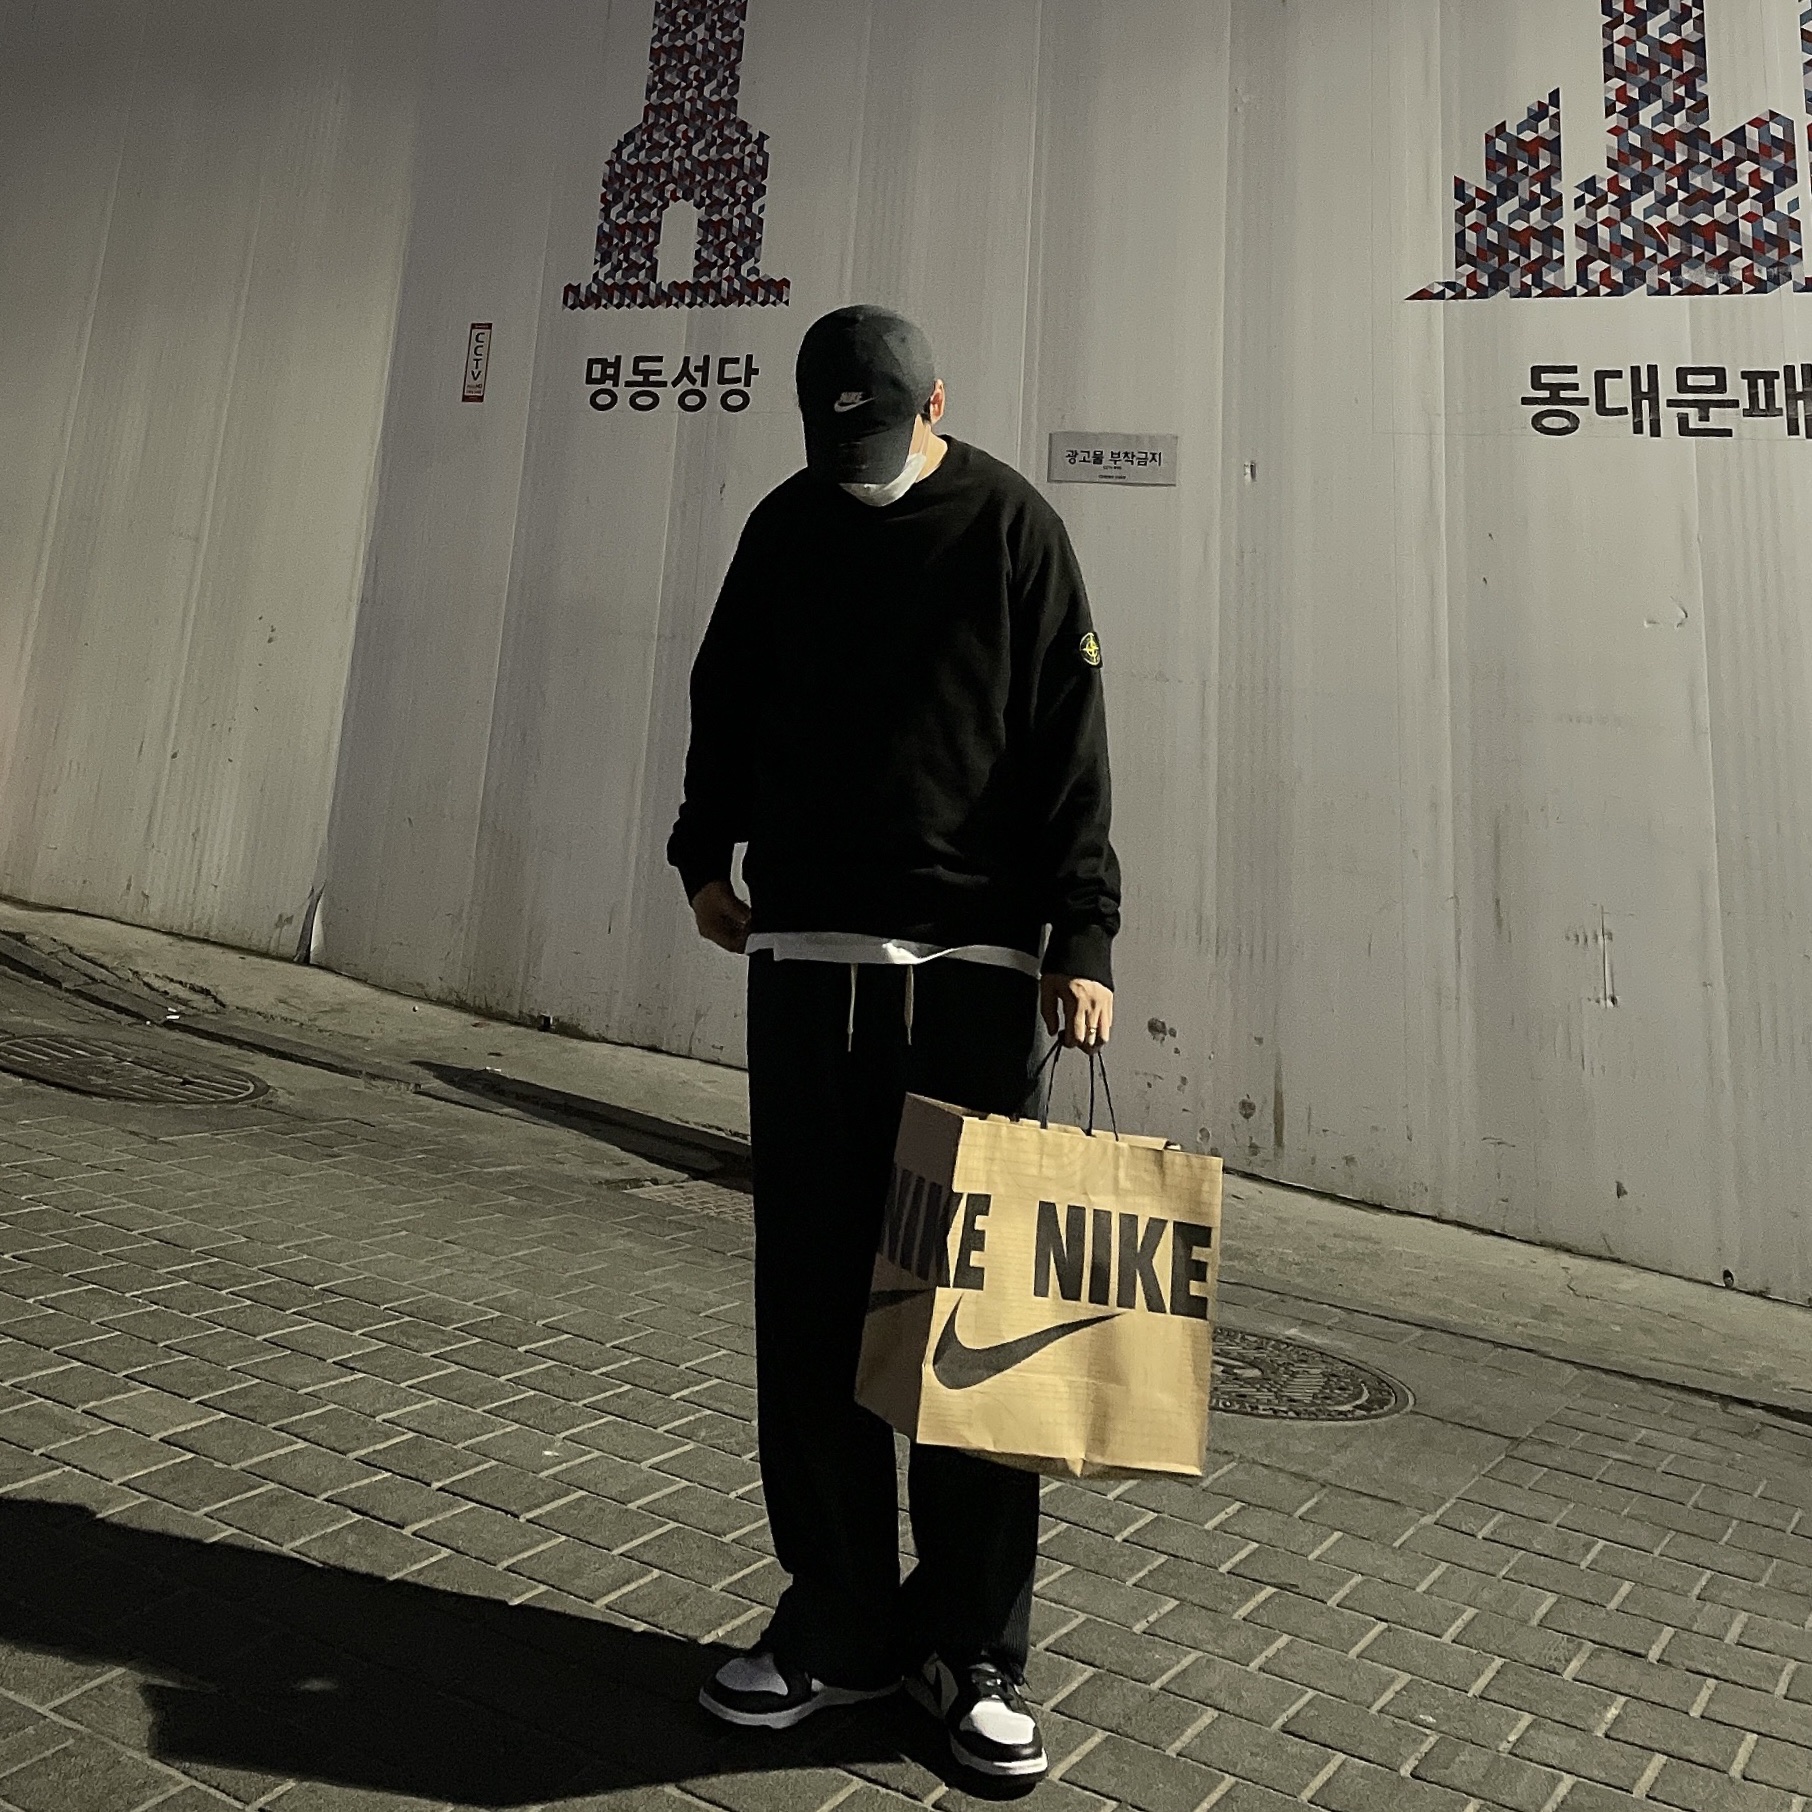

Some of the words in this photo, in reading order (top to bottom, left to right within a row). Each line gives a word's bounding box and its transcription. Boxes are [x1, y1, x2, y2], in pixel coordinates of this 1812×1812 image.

[471, 332, 485, 381] CCTV
[585, 354, 760, 413] 명동성당
[1065, 449, 1105, 465] 광고물
[1109, 450, 1162, 467] 부착금지
[1033, 1200, 1213, 1320] NIKE
